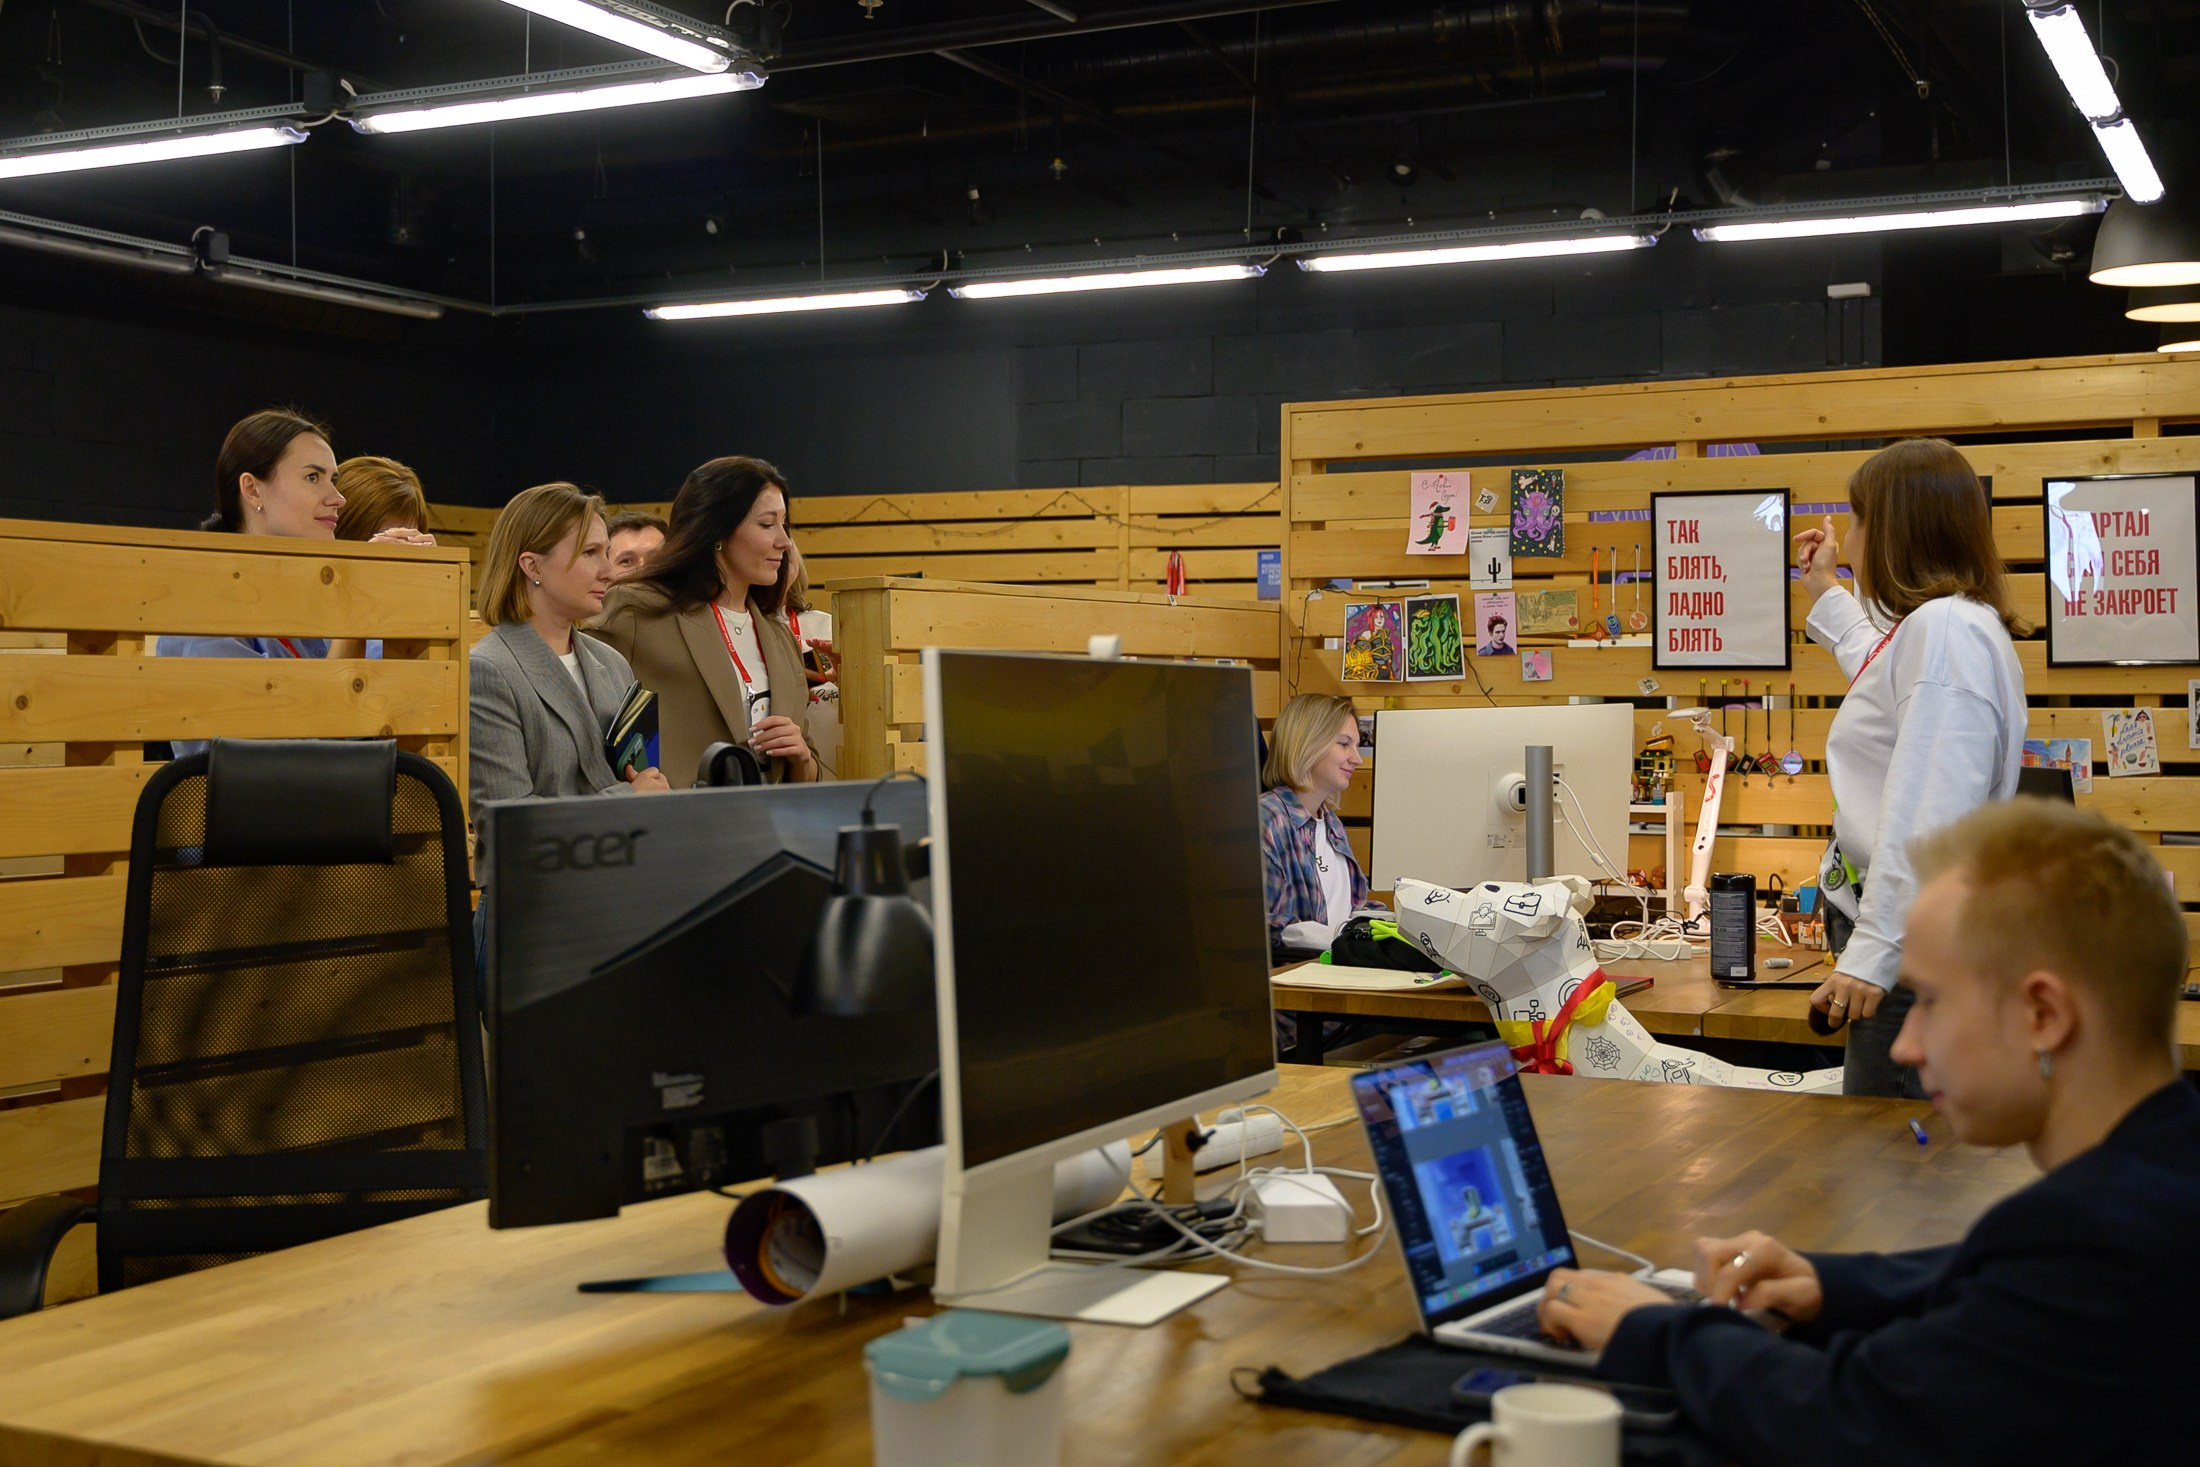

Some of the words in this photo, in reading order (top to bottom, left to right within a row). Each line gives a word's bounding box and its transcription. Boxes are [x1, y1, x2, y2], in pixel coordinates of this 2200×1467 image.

[1667, 519, 1700, 544] ТАК
[2089, 511, 2150, 537] АРТАЛ
[1667, 555, 1728, 583] БЛЯТЬ,
[2112, 549, 2160, 577] СЕБЯ
[1667, 591, 1725, 620] ЛАДНО
[2065, 590, 2087, 616] НЕ
[2093, 588, 2178, 616] ЗАКРОЕТ
[1668, 628, 1723, 652] БЛЯТЬ
[2120, 738, 2146, 759] please
[530, 829, 648, 873] acer
